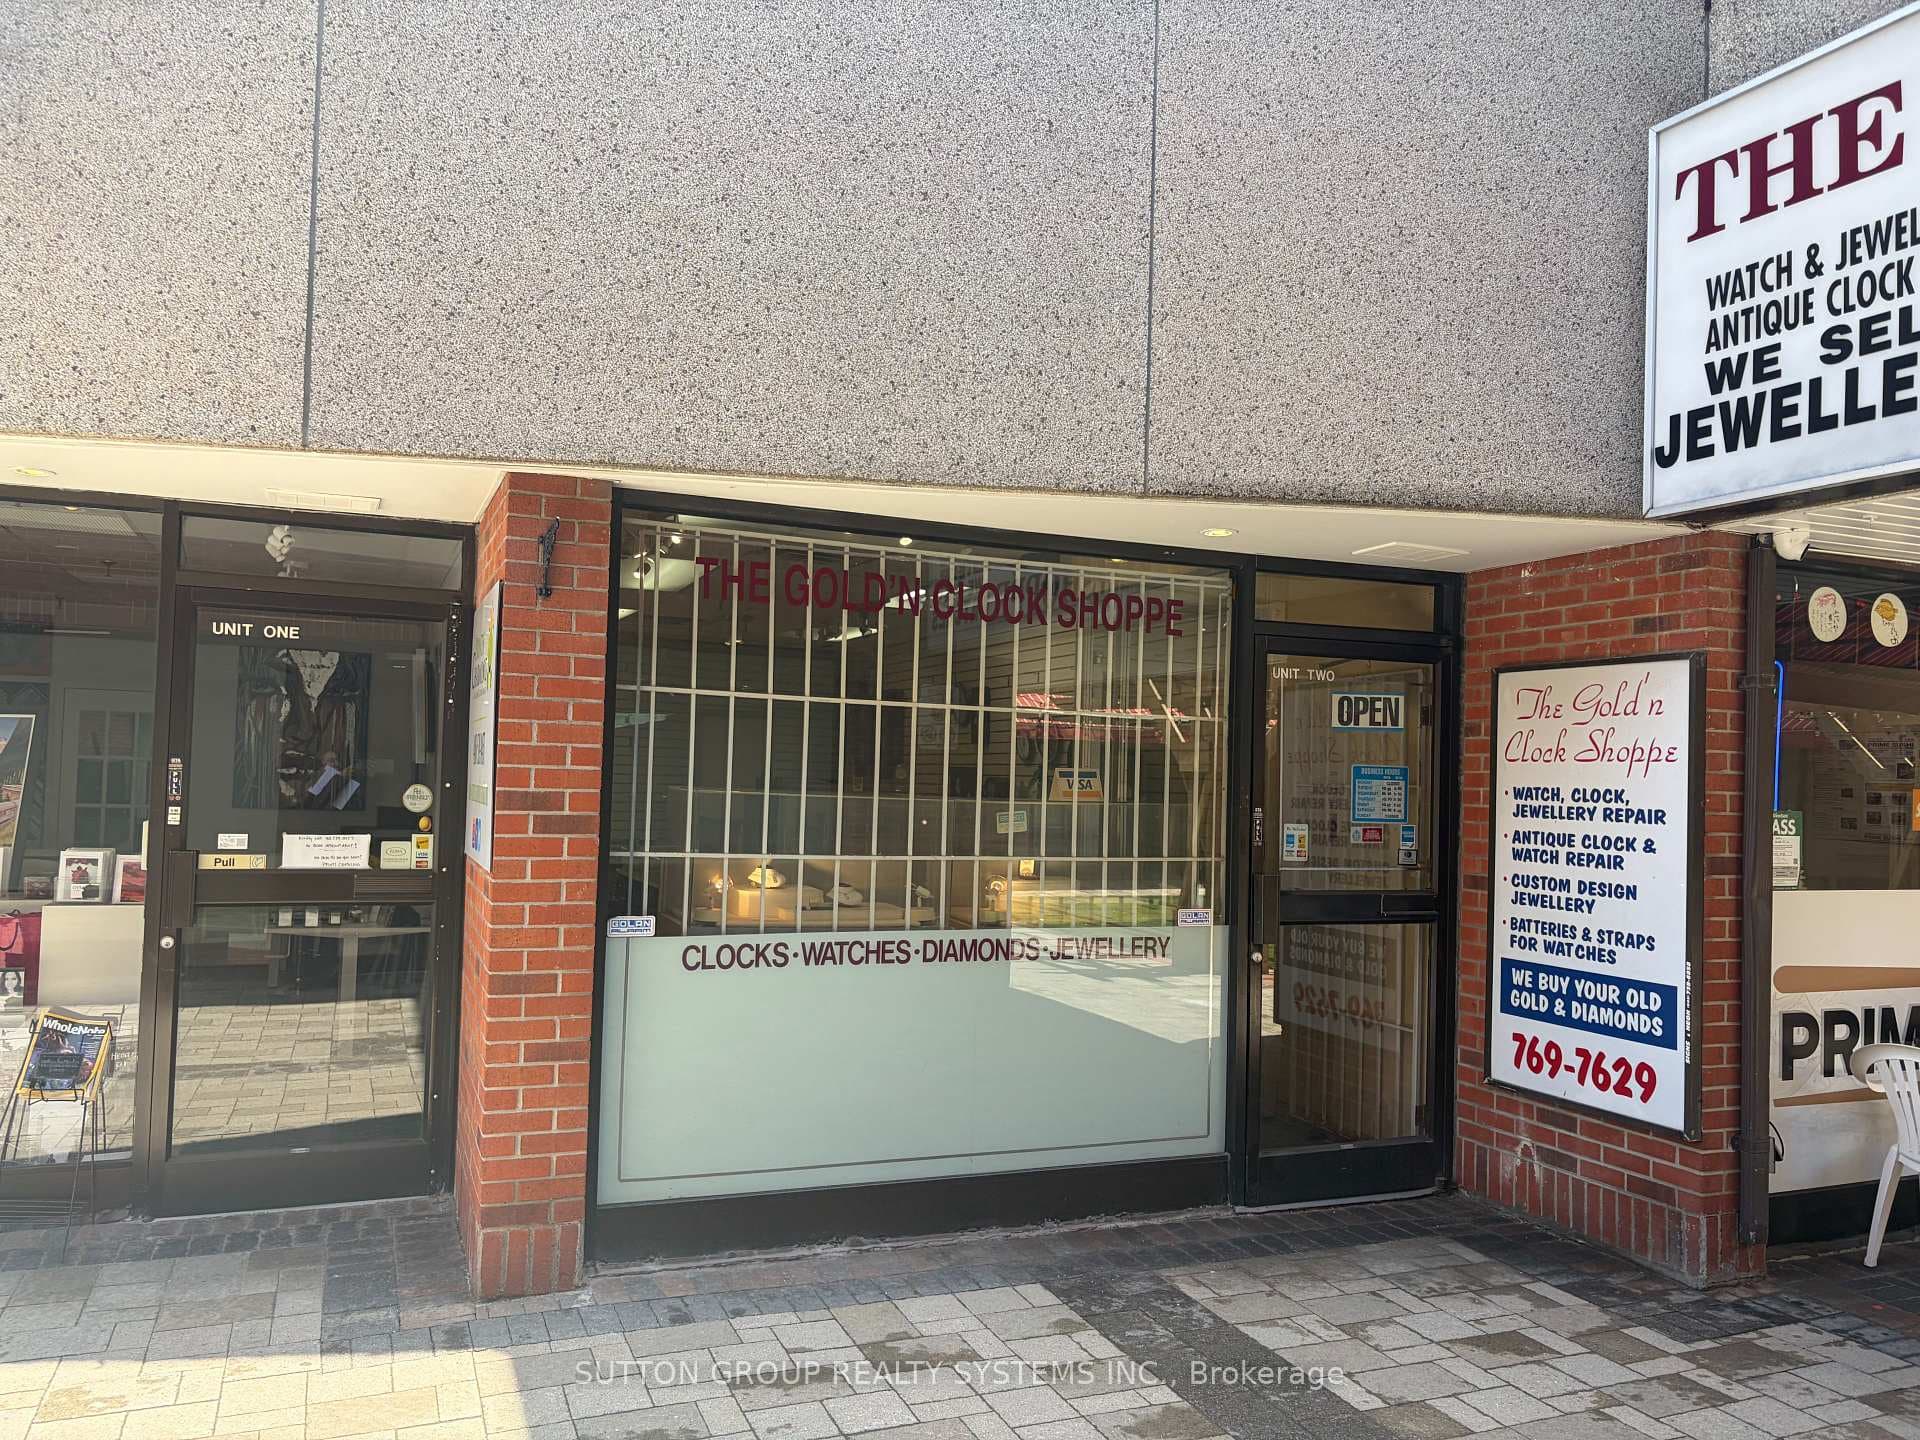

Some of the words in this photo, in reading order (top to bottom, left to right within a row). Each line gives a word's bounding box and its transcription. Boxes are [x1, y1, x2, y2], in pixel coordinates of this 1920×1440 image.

[1676, 80, 1904, 244] THE
[1706, 250, 1793, 312] WATCH
[1805, 242, 1824, 278] &
[1705, 287, 1815, 355] ANTIQUE
[1827, 256, 1915, 317] CLOCK
[1705, 342, 1782, 396] WE
[1655, 352, 1919, 469] JEWELLE
[696, 557, 770, 605] THE
[784, 563, 921, 617] GOLD'N
[932, 579, 1048, 626] CLOCK
[1058, 589, 1184, 637] SHOPPE
[212, 621, 254, 637] UNIT
[263, 625, 300, 640] ONE
[1272, 666, 1301, 680] UNIT
[1307, 669, 1336, 682] TWO
[1337, 695, 1400, 727] OPEN
[1517, 685, 1563, 720] The
[1504, 727, 1567, 764] Clock
[1573, 726, 1678, 779] Shoppe
[1066, 779, 1093, 790] VSA
[1513, 786, 1565, 804] WATCH,
[1571, 788, 1631, 806] CLOCK,
[1512, 804, 1597, 822] JEWELLERY
[1602, 807, 1667, 826] REPAIR
[1512, 830, 1576, 849] ANTIQUE
[1581, 834, 1637, 852] CLOCK
[1642, 838, 1657, 855] &
[1512, 847, 1559, 865] WATCH
[1565, 851, 1625, 871] REPAIR
[214, 858, 235, 867] Pull
[1511, 873, 1571, 894] CUSTOM
[1577, 880, 1638, 901] DESIGN
[1511, 891, 1595, 915] JEWELLERY
[611, 919, 652, 929] GOLAN
[1510, 916, 1577, 940] BATTERIES
[1581, 926, 1592, 942] &
[1597, 928, 1656, 951] STRAPS
[682, 942, 790, 972] CLOCKS
[801, 939, 912, 967] WATCHES
[922, 937, 1041, 963] DIAMONDS
[1049, 936, 1171, 961] JEWELLERY
[1510, 934, 1538, 952] FOR
[1543, 939, 1617, 965] WATCHES
[1511, 967, 1533, 988] WE
[1538, 972, 1570, 995] BUY
[1574, 978, 1621, 1005] YOUR
[1626, 988, 1662, 1012] OLD
[1510, 989, 1549, 1013] GOLD
[1554, 999, 1566, 1017] &
[1571, 1001, 1663, 1037] DIAMONDS
[1512, 1032, 1657, 1104] 769-7629
